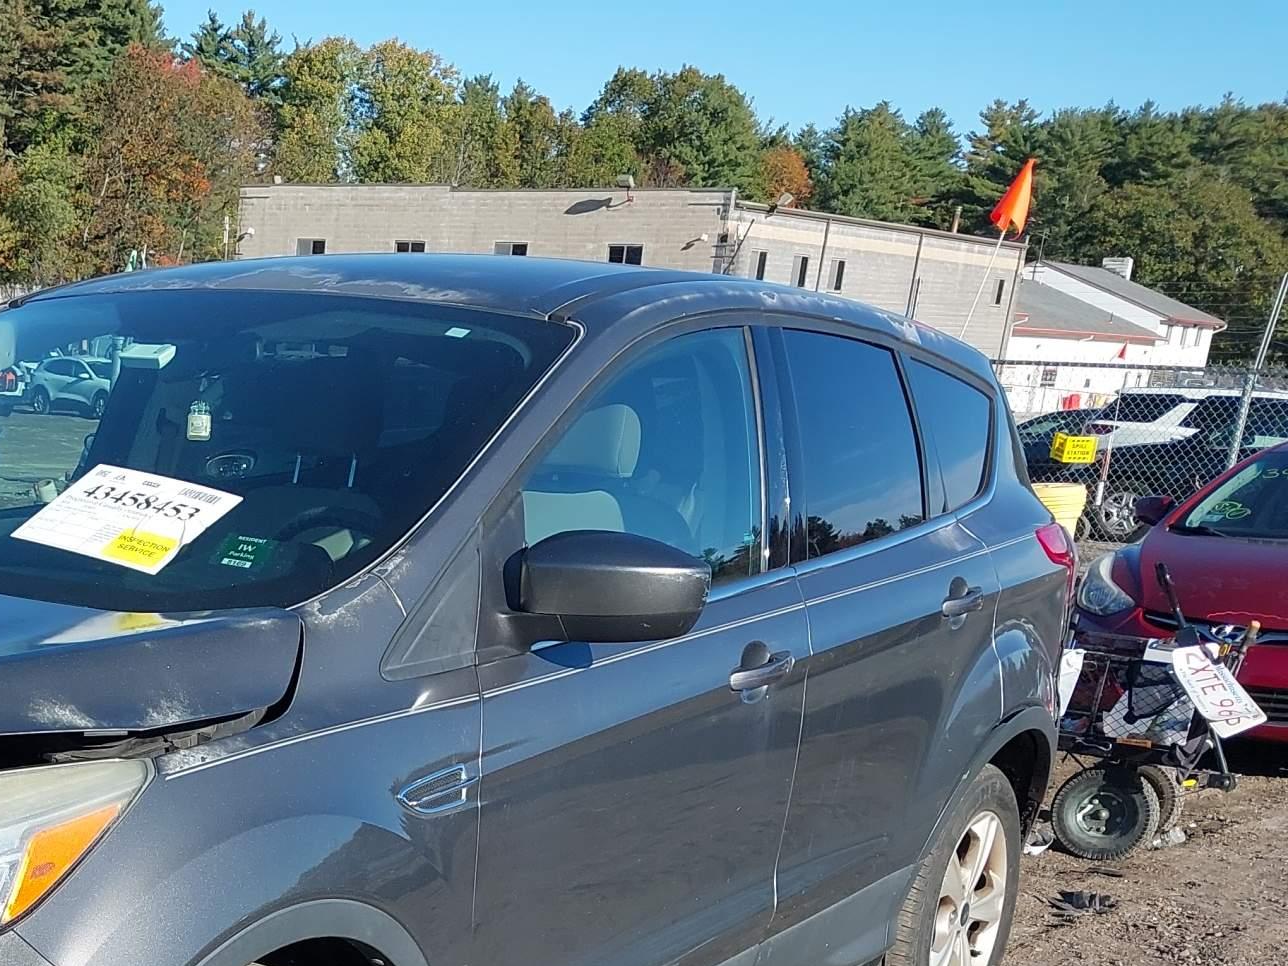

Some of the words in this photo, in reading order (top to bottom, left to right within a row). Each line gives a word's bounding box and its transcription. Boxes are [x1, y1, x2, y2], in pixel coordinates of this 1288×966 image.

[83, 484, 201, 521] 43458453
[116, 543, 155, 558] SERVICE
[117, 534, 171, 553] INSPECTION
[1185, 652, 1228, 696] 2XTE
